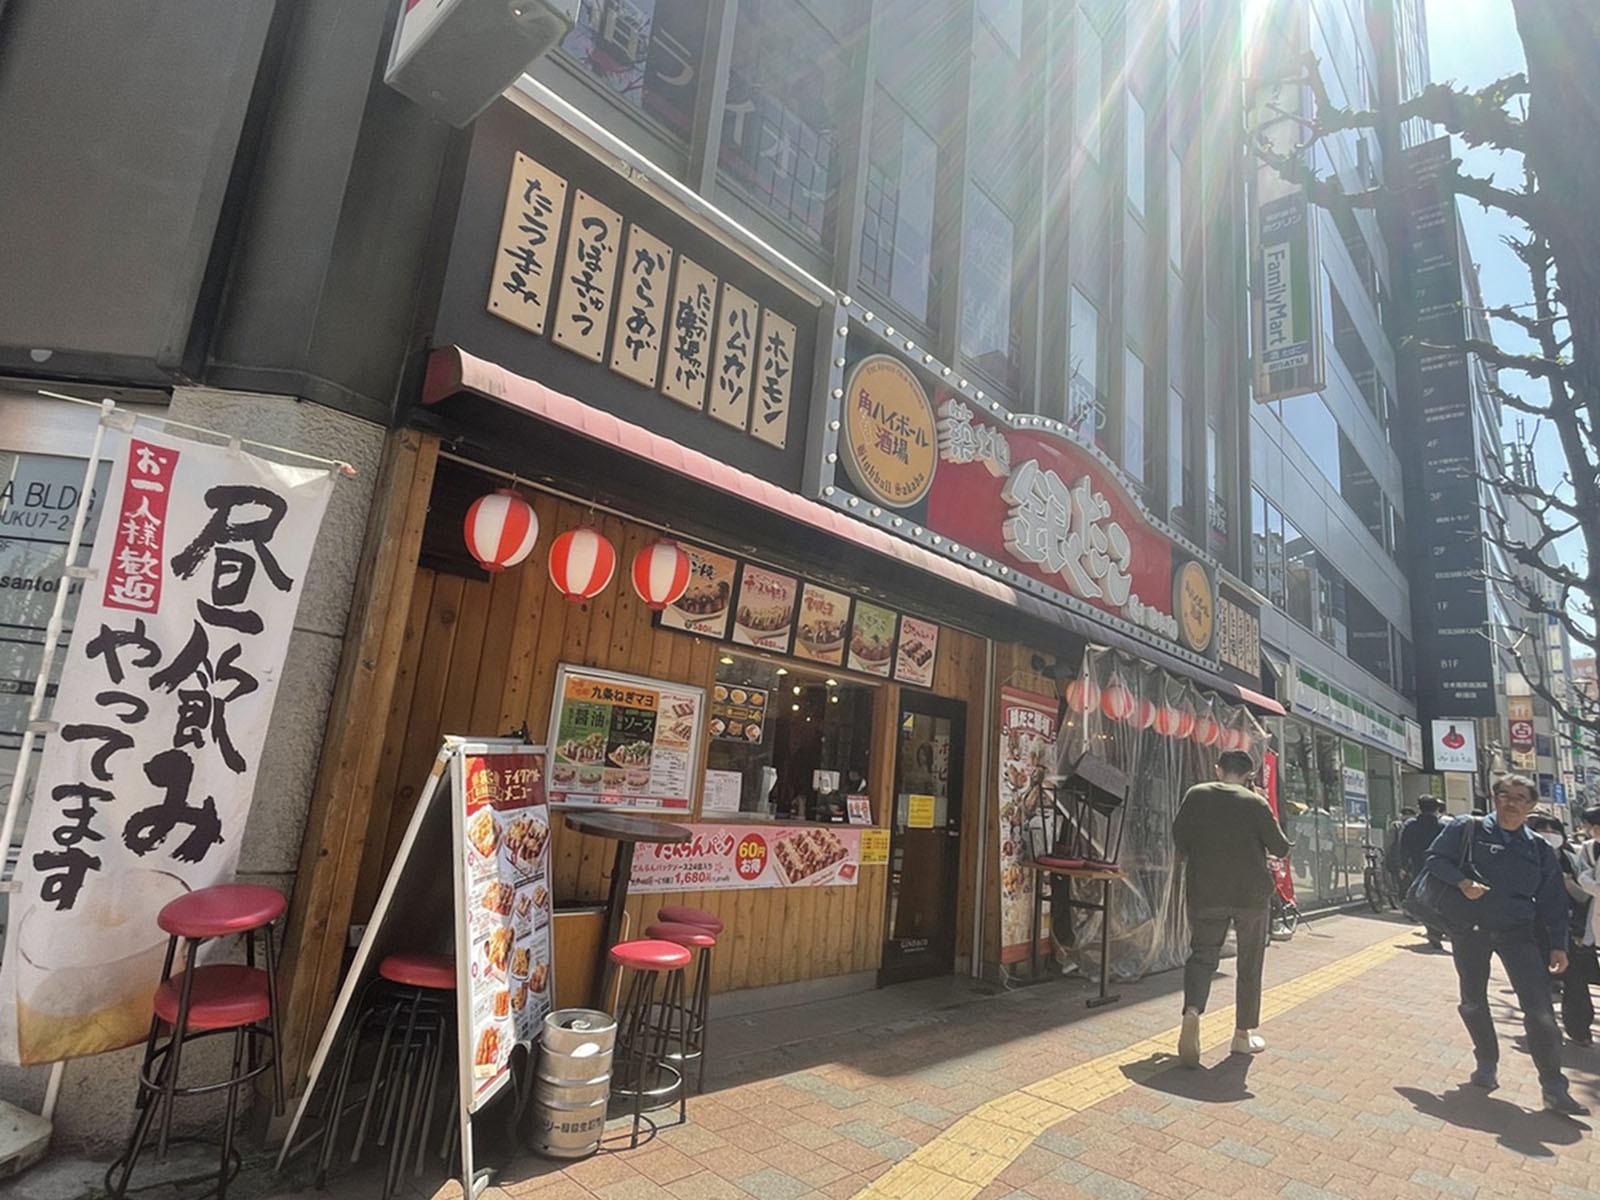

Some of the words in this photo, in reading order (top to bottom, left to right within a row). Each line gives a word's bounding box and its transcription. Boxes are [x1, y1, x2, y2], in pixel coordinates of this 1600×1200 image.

[625, 246, 666, 362] からあげ
[1266, 249, 1288, 348] FamilyMart
[719, 307, 751, 405] ハムカツ
[762, 330, 790, 425] ホルモン
[857, 387, 929, 448] 角ハイボール
[875, 427, 910, 465] 酒場
[108, 446, 168, 608] お一人様歓迎
[1002, 459, 1132, 606] 銀だこ
[121, 484, 294, 864] 昼飲み
[591, 686, 654, 707] 九条ねぎマヨ
[32, 617, 162, 912] やってます
[623, 714, 655, 733] ソース
[504, 785, 533, 801] メニュー
[738, 841, 767, 858] 60円
[740, 859, 761, 874] お得
